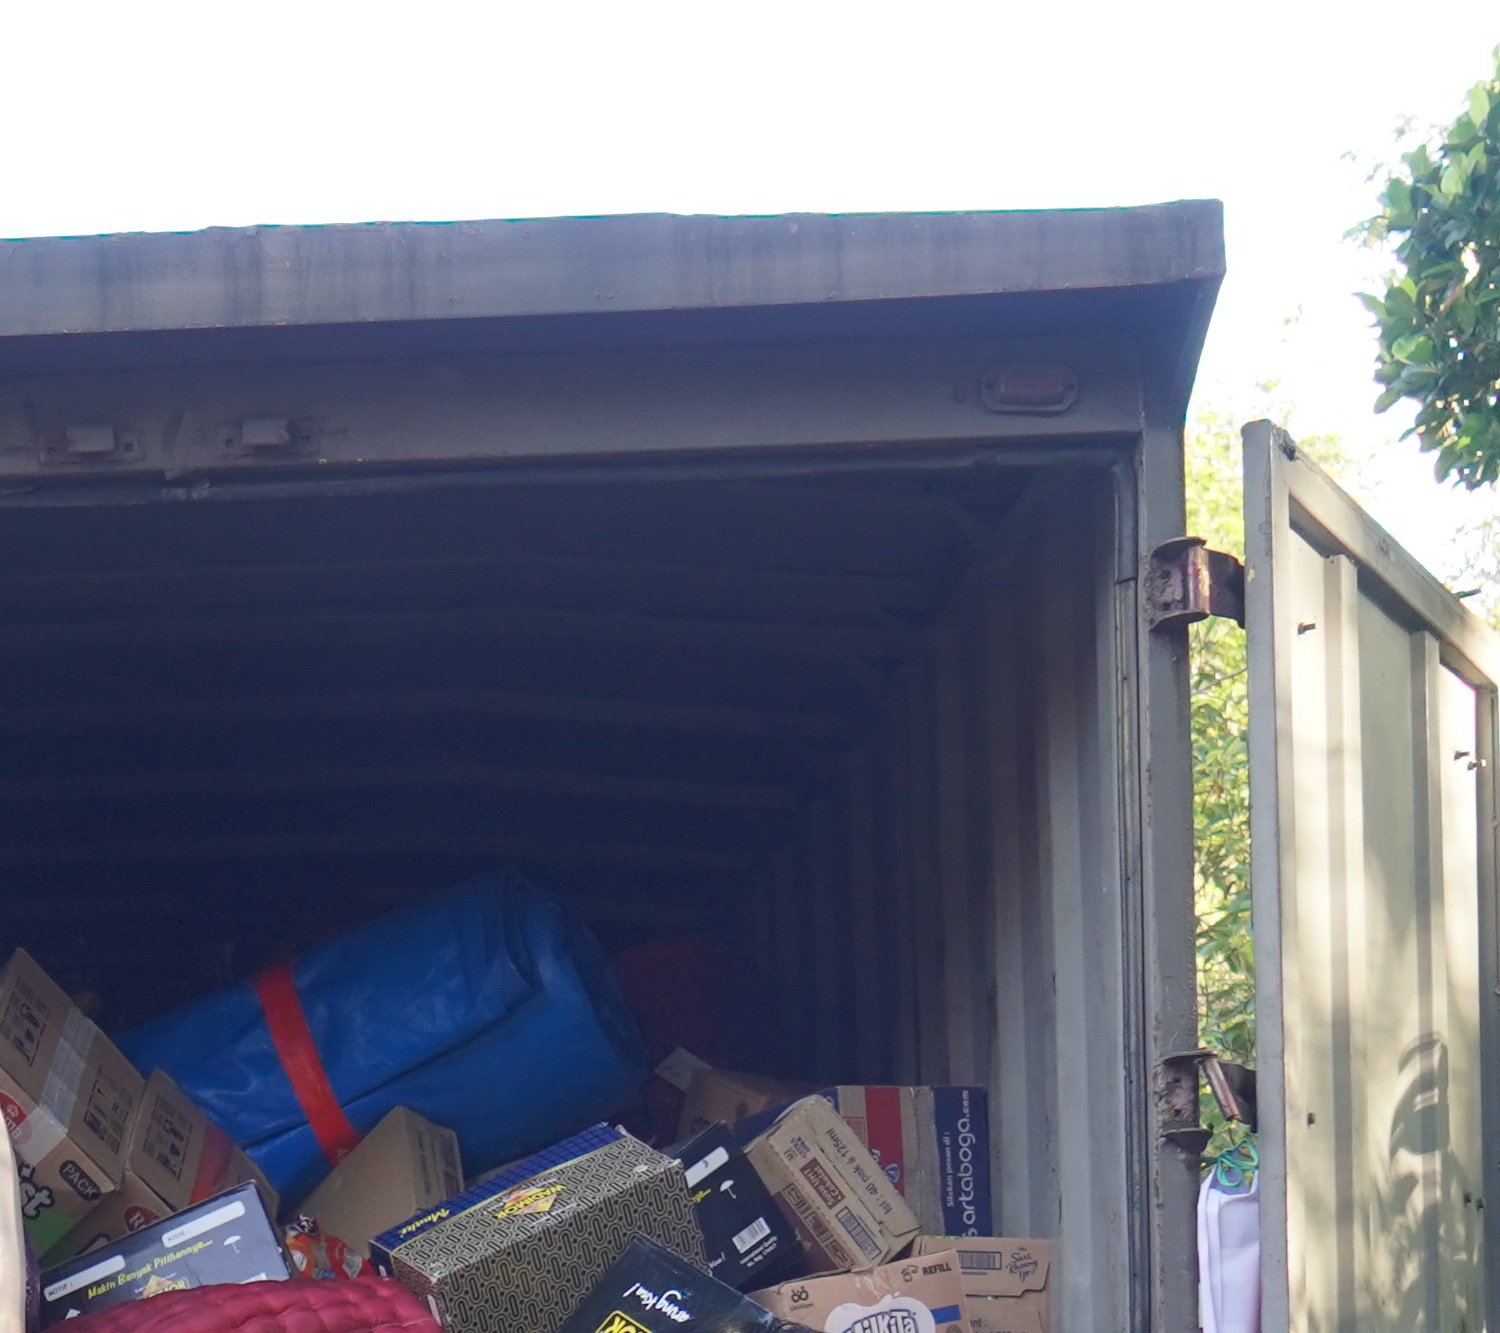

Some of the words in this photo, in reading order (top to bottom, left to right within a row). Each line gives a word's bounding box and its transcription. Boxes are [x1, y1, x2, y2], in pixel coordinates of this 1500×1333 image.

[62, 1162, 97, 1199] PACK
[495, 1184, 567, 1219] WADIMOR
[88, 1281, 116, 1299] Makin
[117, 1262, 154, 1286] Banyak
[922, 1263, 952, 1276] REFILL
